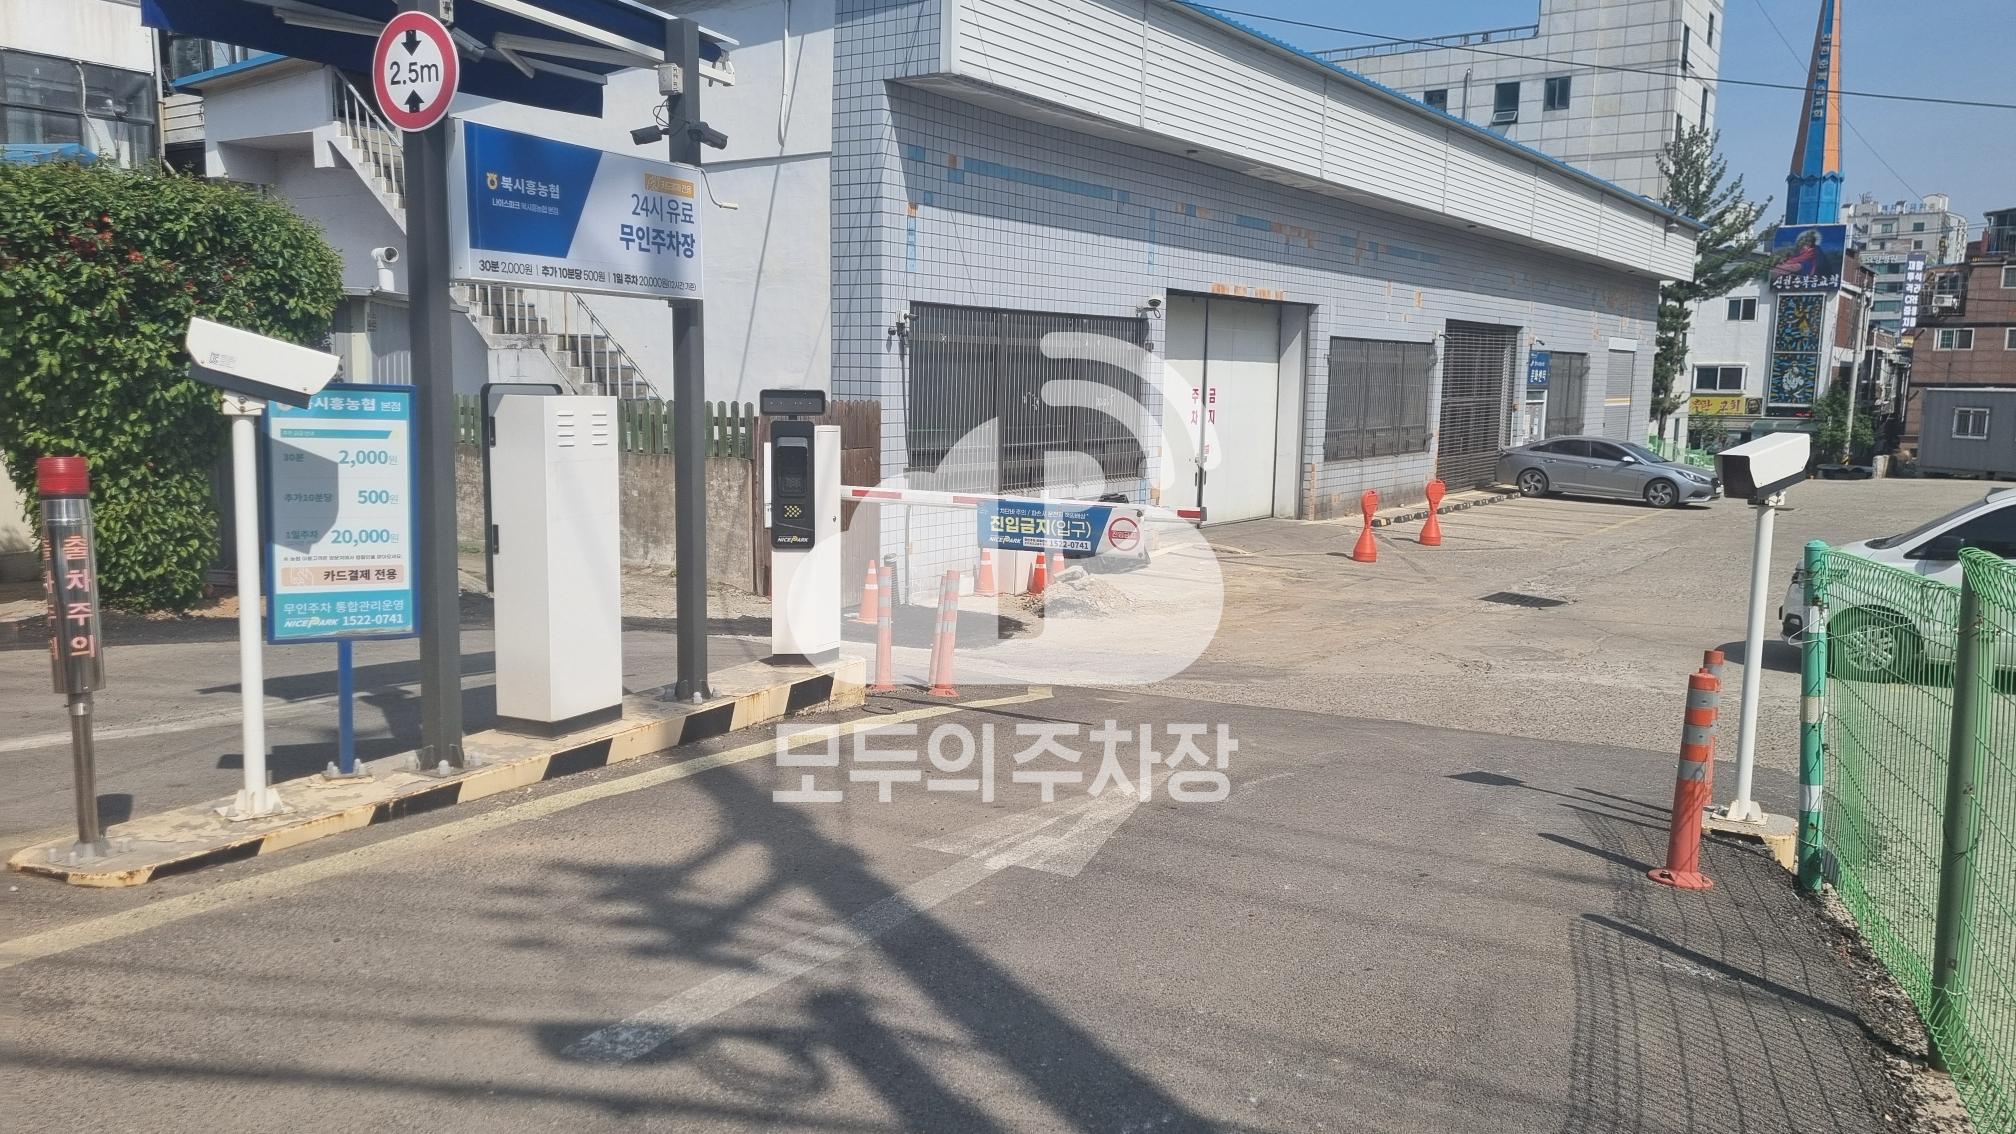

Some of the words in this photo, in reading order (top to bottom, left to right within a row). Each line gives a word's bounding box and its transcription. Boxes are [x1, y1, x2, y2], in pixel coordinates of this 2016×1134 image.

[389, 61, 439, 86] 2.5m
[500, 175, 560, 199] 북시흥농협
[492, 198, 520, 209] 나이스파크
[631, 193, 663, 222] 24시
[666, 199, 695, 225] 유료
[619, 223, 696, 259] 무인주차장
[478, 259, 500, 273] 30분
[501, 261, 533, 276] 2,000원
[541, 265, 557, 277] 추가
[558, 267, 583, 280] 10분당
[583, 269, 606, 282] 500원
[612, 272, 624, 285] 1일
[624, 273, 639, 286] 주차
[307, 396, 376, 412] 시흥농협
[380, 401, 401, 412] 본점
[338, 449, 398, 468] 2,000원
[284, 492, 333, 503] 추가10분당
[357, 489, 399, 505] 500원
[990, 515, 1092, 539] 진입금지(입구)
[285, 529, 320, 541] 1일주차
[331, 528, 400, 546] 20,000원
[1049, 540, 1089, 550] 1522-0741
[323, 569, 371, 581] 카드결제
[374, 568, 398, 581] 전용
[62, 535, 96, 658] 출차주의
[284, 602, 332, 615] 무인주차
[335, 600, 404, 613] 통합관리운영
[342, 614, 404, 626] 1522-0741
